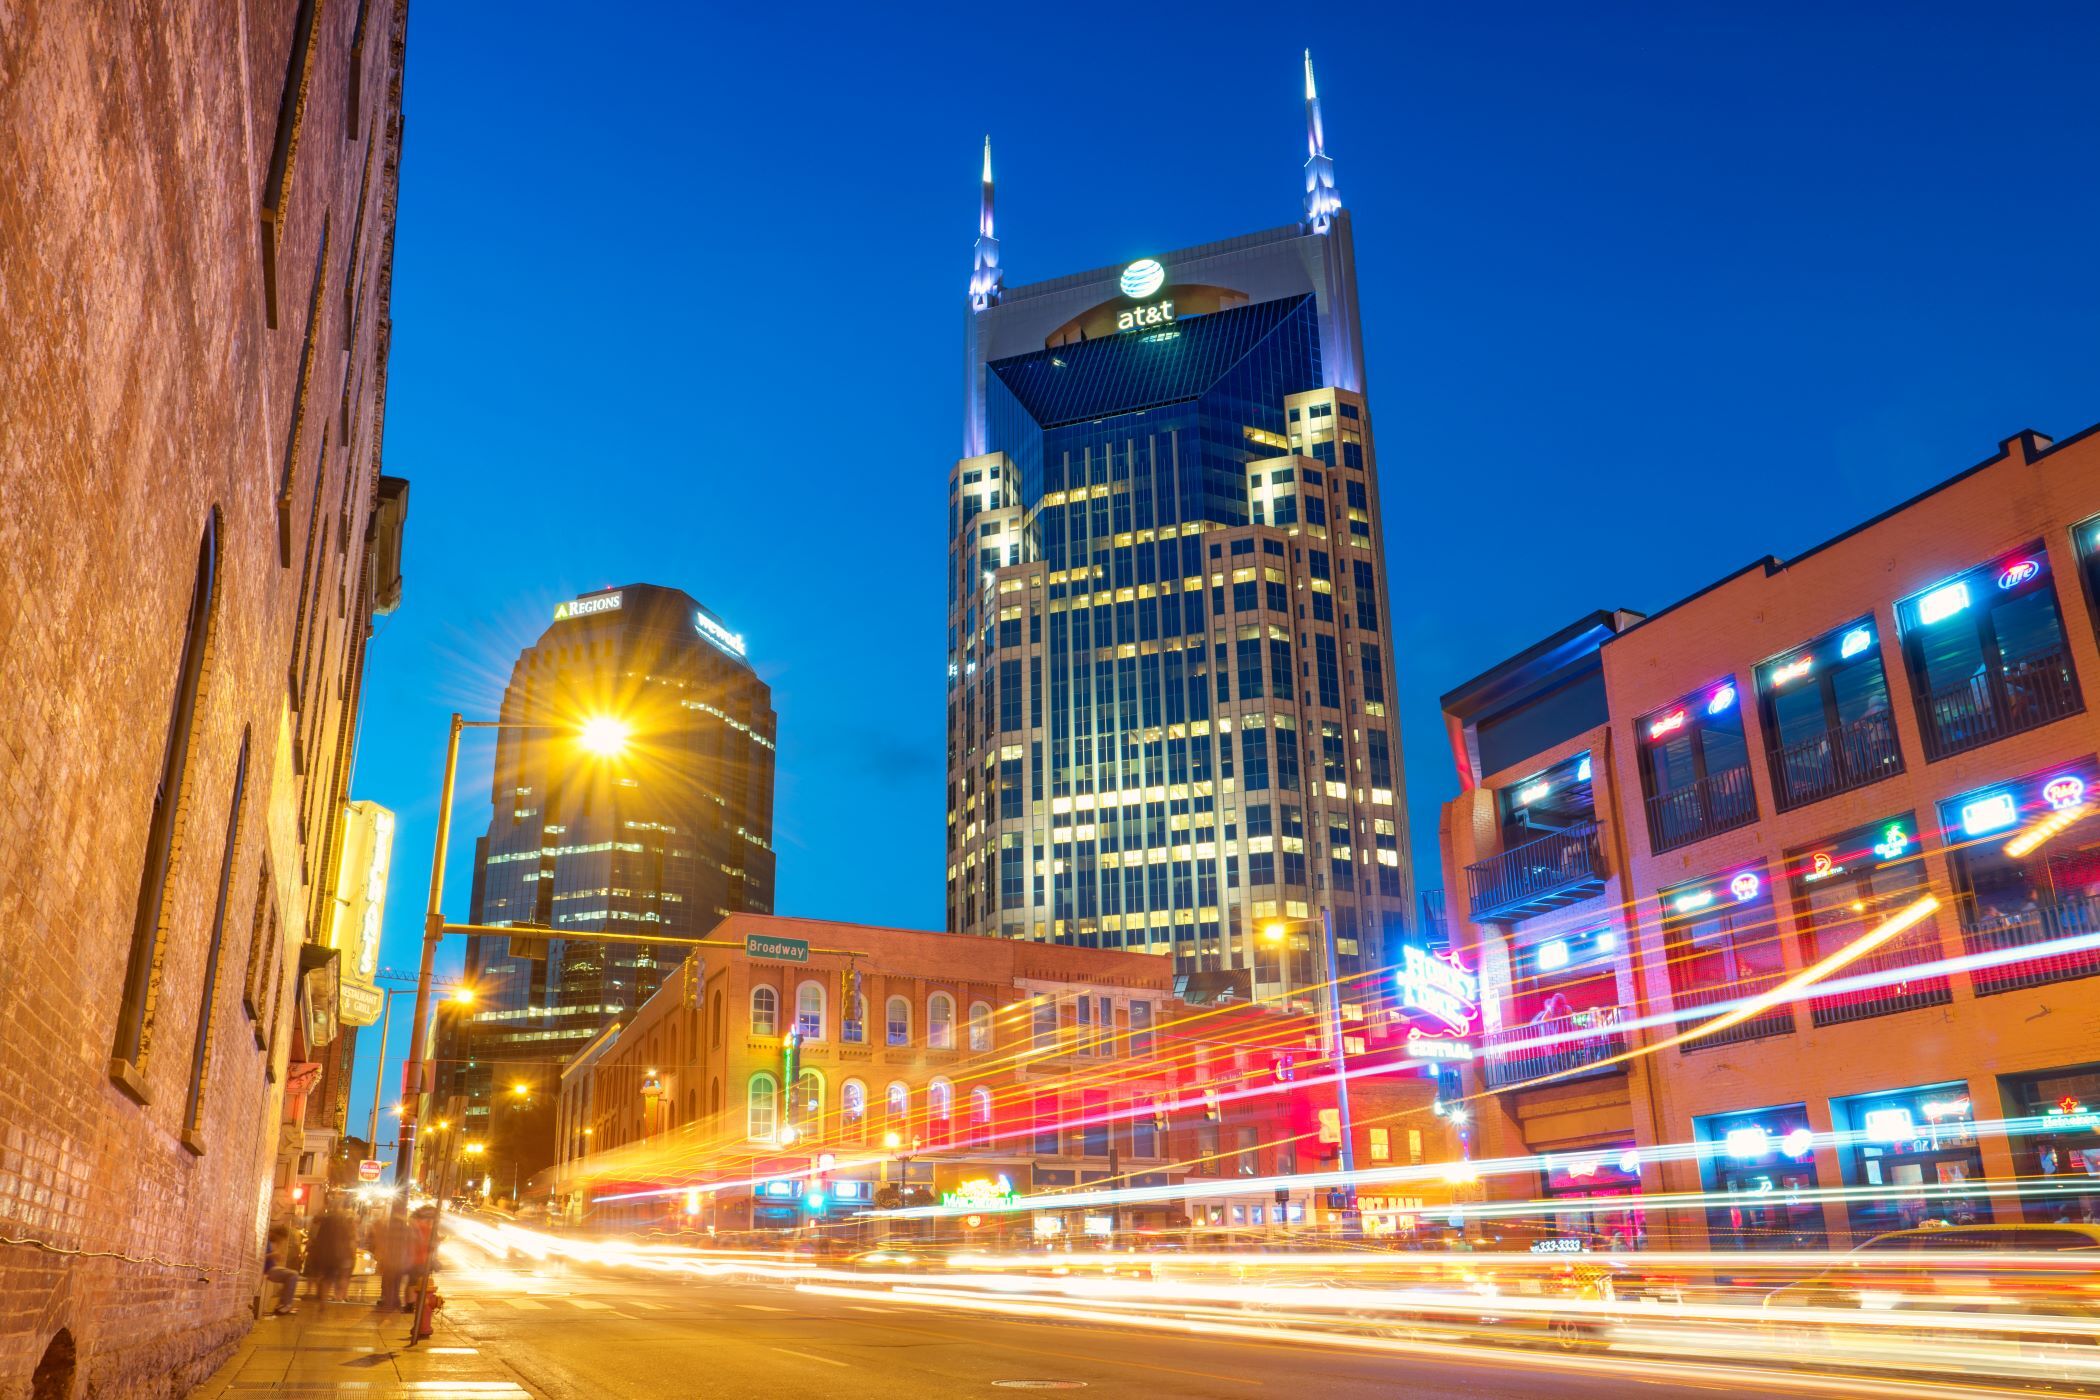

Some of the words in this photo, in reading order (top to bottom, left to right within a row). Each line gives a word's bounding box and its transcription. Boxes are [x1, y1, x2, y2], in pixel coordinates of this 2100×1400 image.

[1118, 299, 1173, 330] at&t
[749, 939, 805, 959] Broadway
[1538, 1239, 1581, 1253] 333-3333
